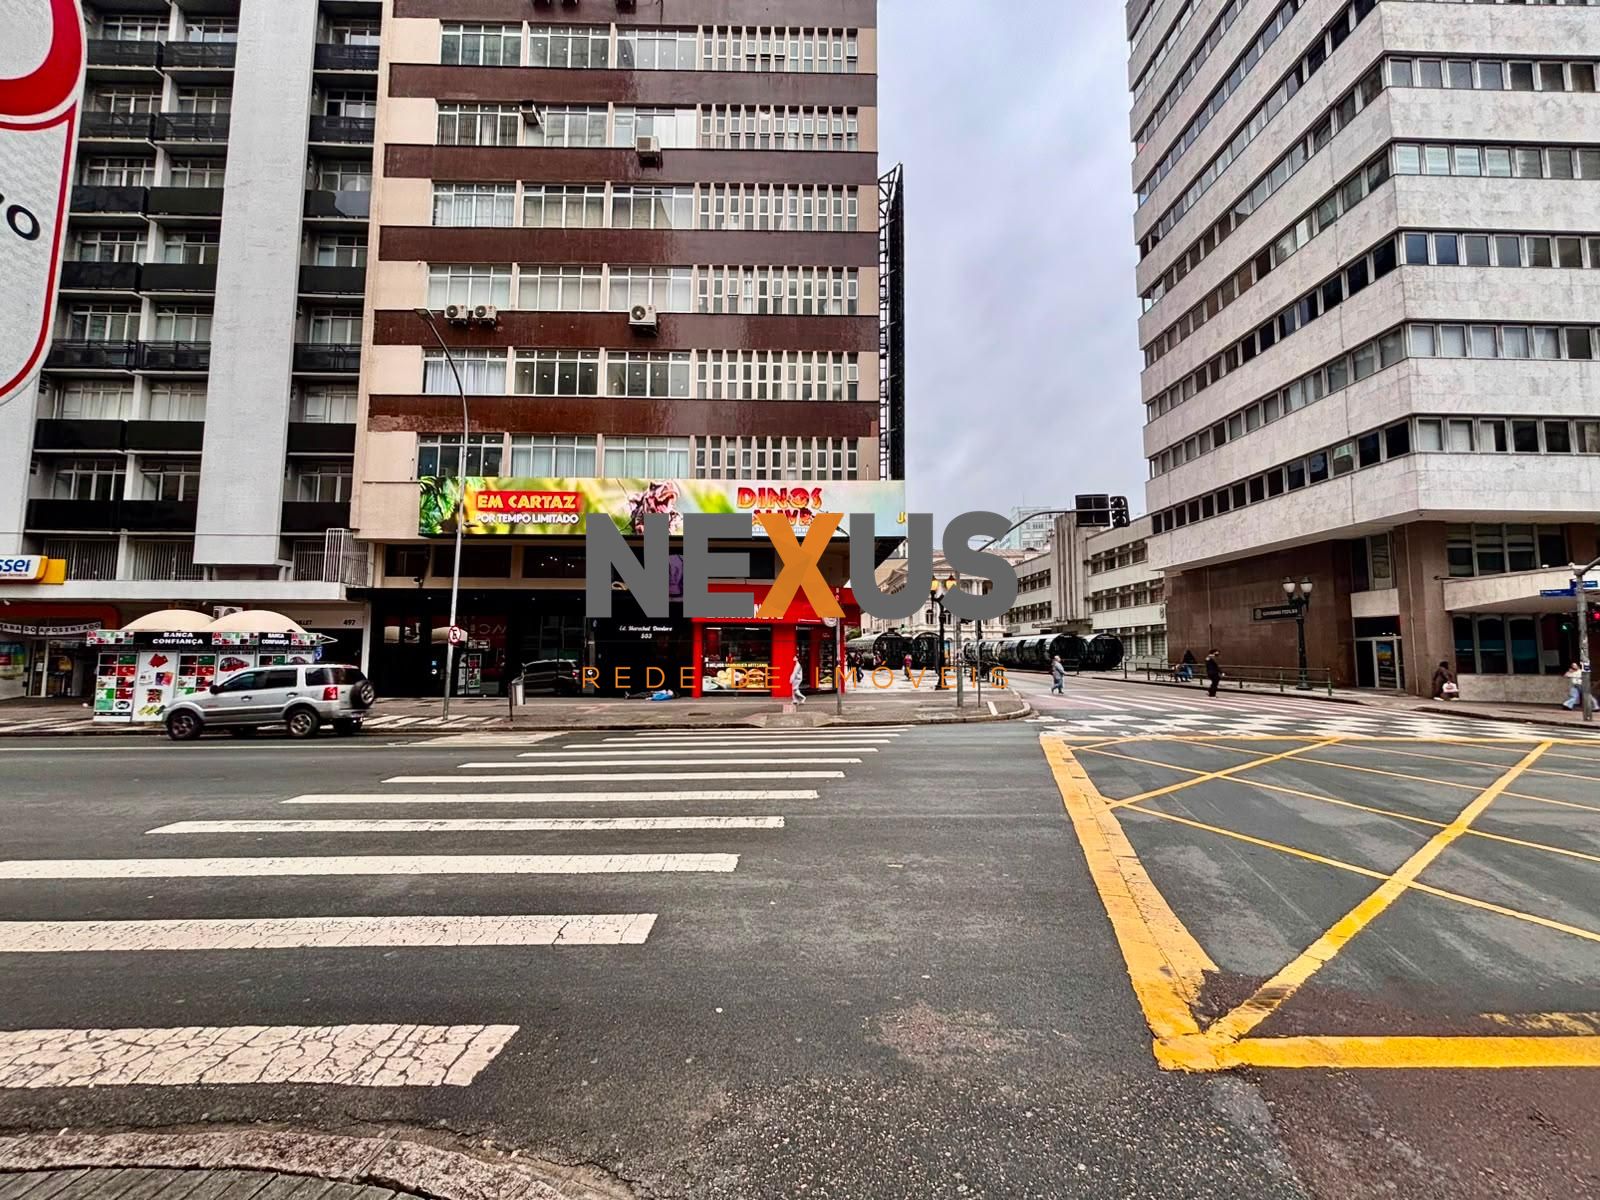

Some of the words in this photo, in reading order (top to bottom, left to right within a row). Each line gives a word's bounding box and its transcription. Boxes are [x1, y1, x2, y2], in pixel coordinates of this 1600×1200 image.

[477, 495, 504, 509] EM
[508, 495, 576, 509] CARTAZ
[737, 487, 822, 509] DINOS
[476, 513, 496, 524] POR
[497, 513, 531, 524] TEMPO
[532, 513, 579, 524] LIMITADO
[261, 639, 290, 647] CONFIANÇA
